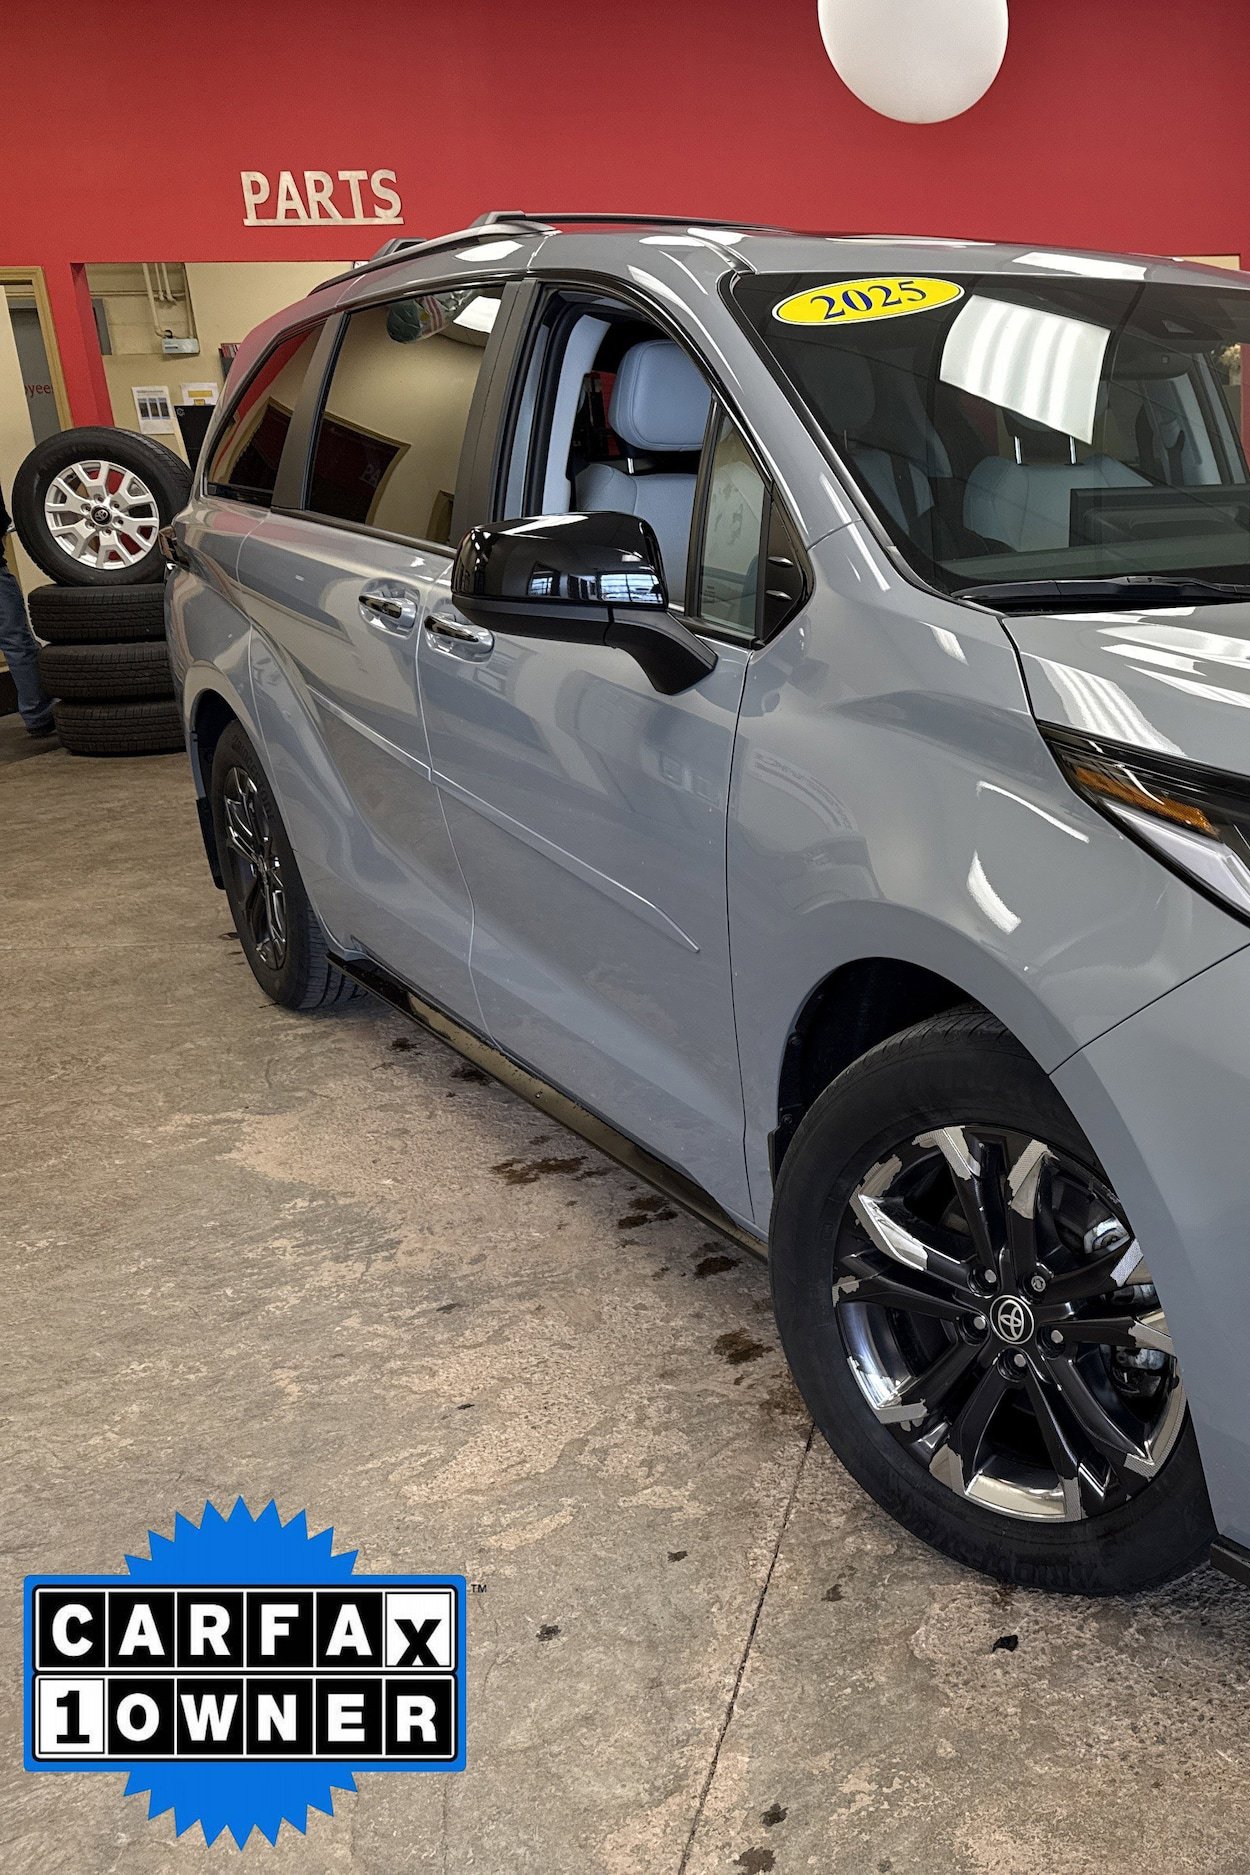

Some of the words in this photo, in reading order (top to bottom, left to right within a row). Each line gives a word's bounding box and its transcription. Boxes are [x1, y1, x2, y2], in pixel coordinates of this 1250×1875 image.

[240, 169, 402, 220] PARTS
[810, 280, 927, 320] 2025
[25, 384, 53, 397] yee
